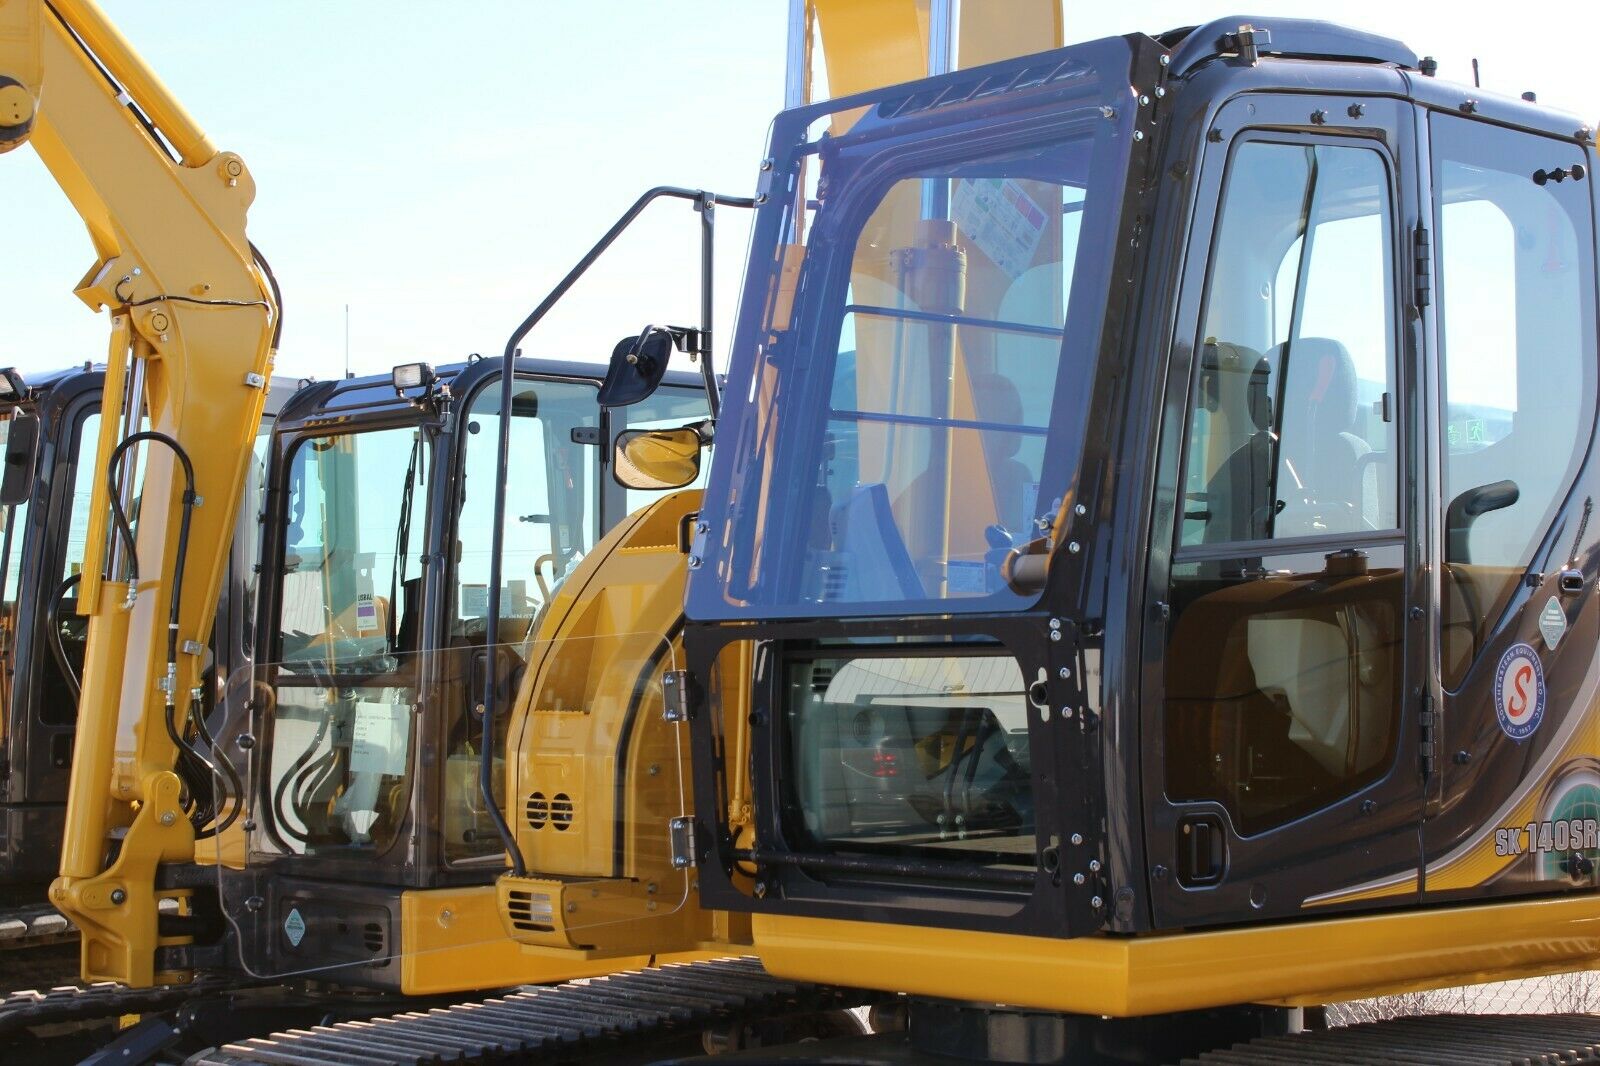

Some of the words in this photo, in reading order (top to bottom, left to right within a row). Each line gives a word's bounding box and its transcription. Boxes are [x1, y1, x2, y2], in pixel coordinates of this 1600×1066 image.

[1497, 651, 1515, 721] SOUTHEASTERN
[1515, 647, 1542, 677] EQUIPMENT
[1508, 665, 1532, 717] S
[1525, 819, 1600, 853] 140SR
